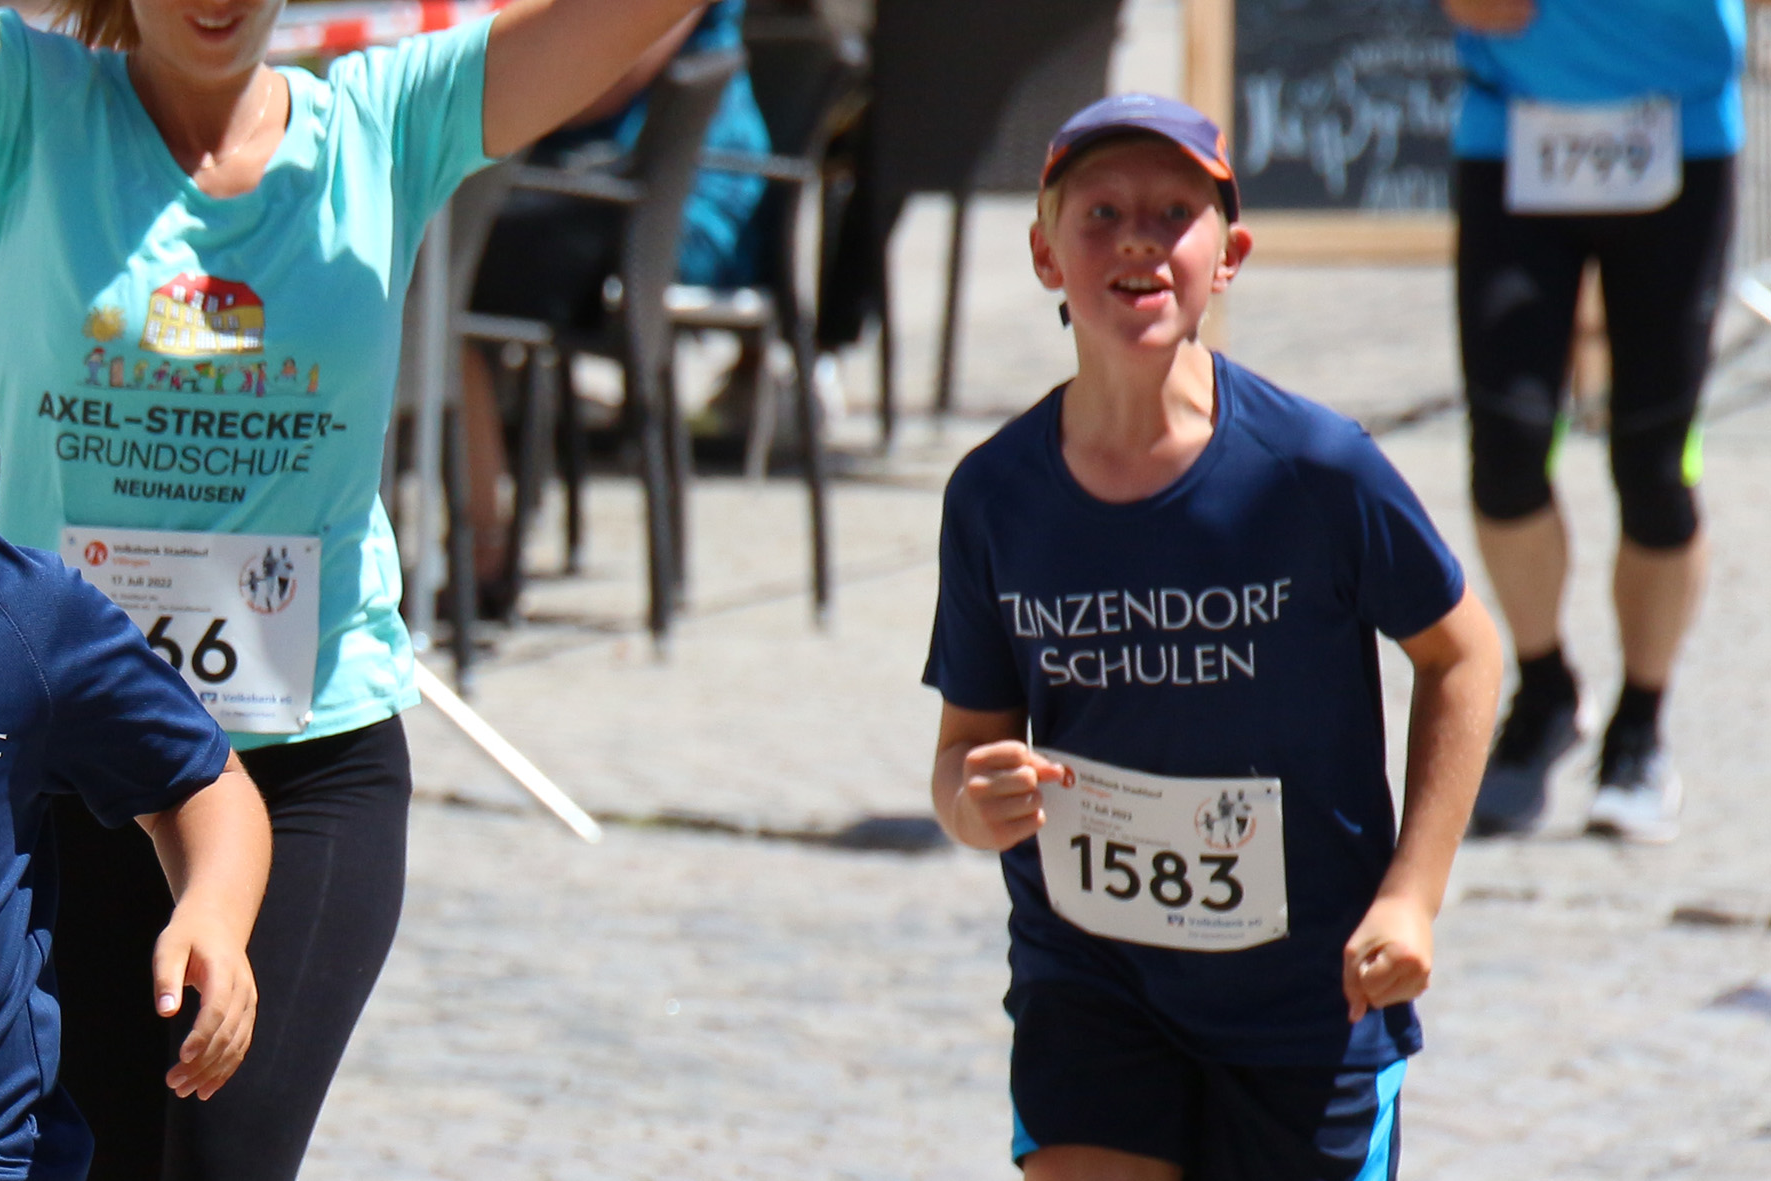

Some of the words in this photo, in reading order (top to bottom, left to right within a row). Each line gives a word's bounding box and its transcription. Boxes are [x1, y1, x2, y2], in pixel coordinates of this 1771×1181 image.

[55, 431, 314, 476] GRUNDSCHULE
[113, 477, 247, 503] NEUHAUSEN
[999, 577, 1292, 638] ZINZENDORF
[146, 615, 238, 685] 66
[1040, 642, 1256, 689] SCHULEN
[1070, 833, 1245, 912] 1583
